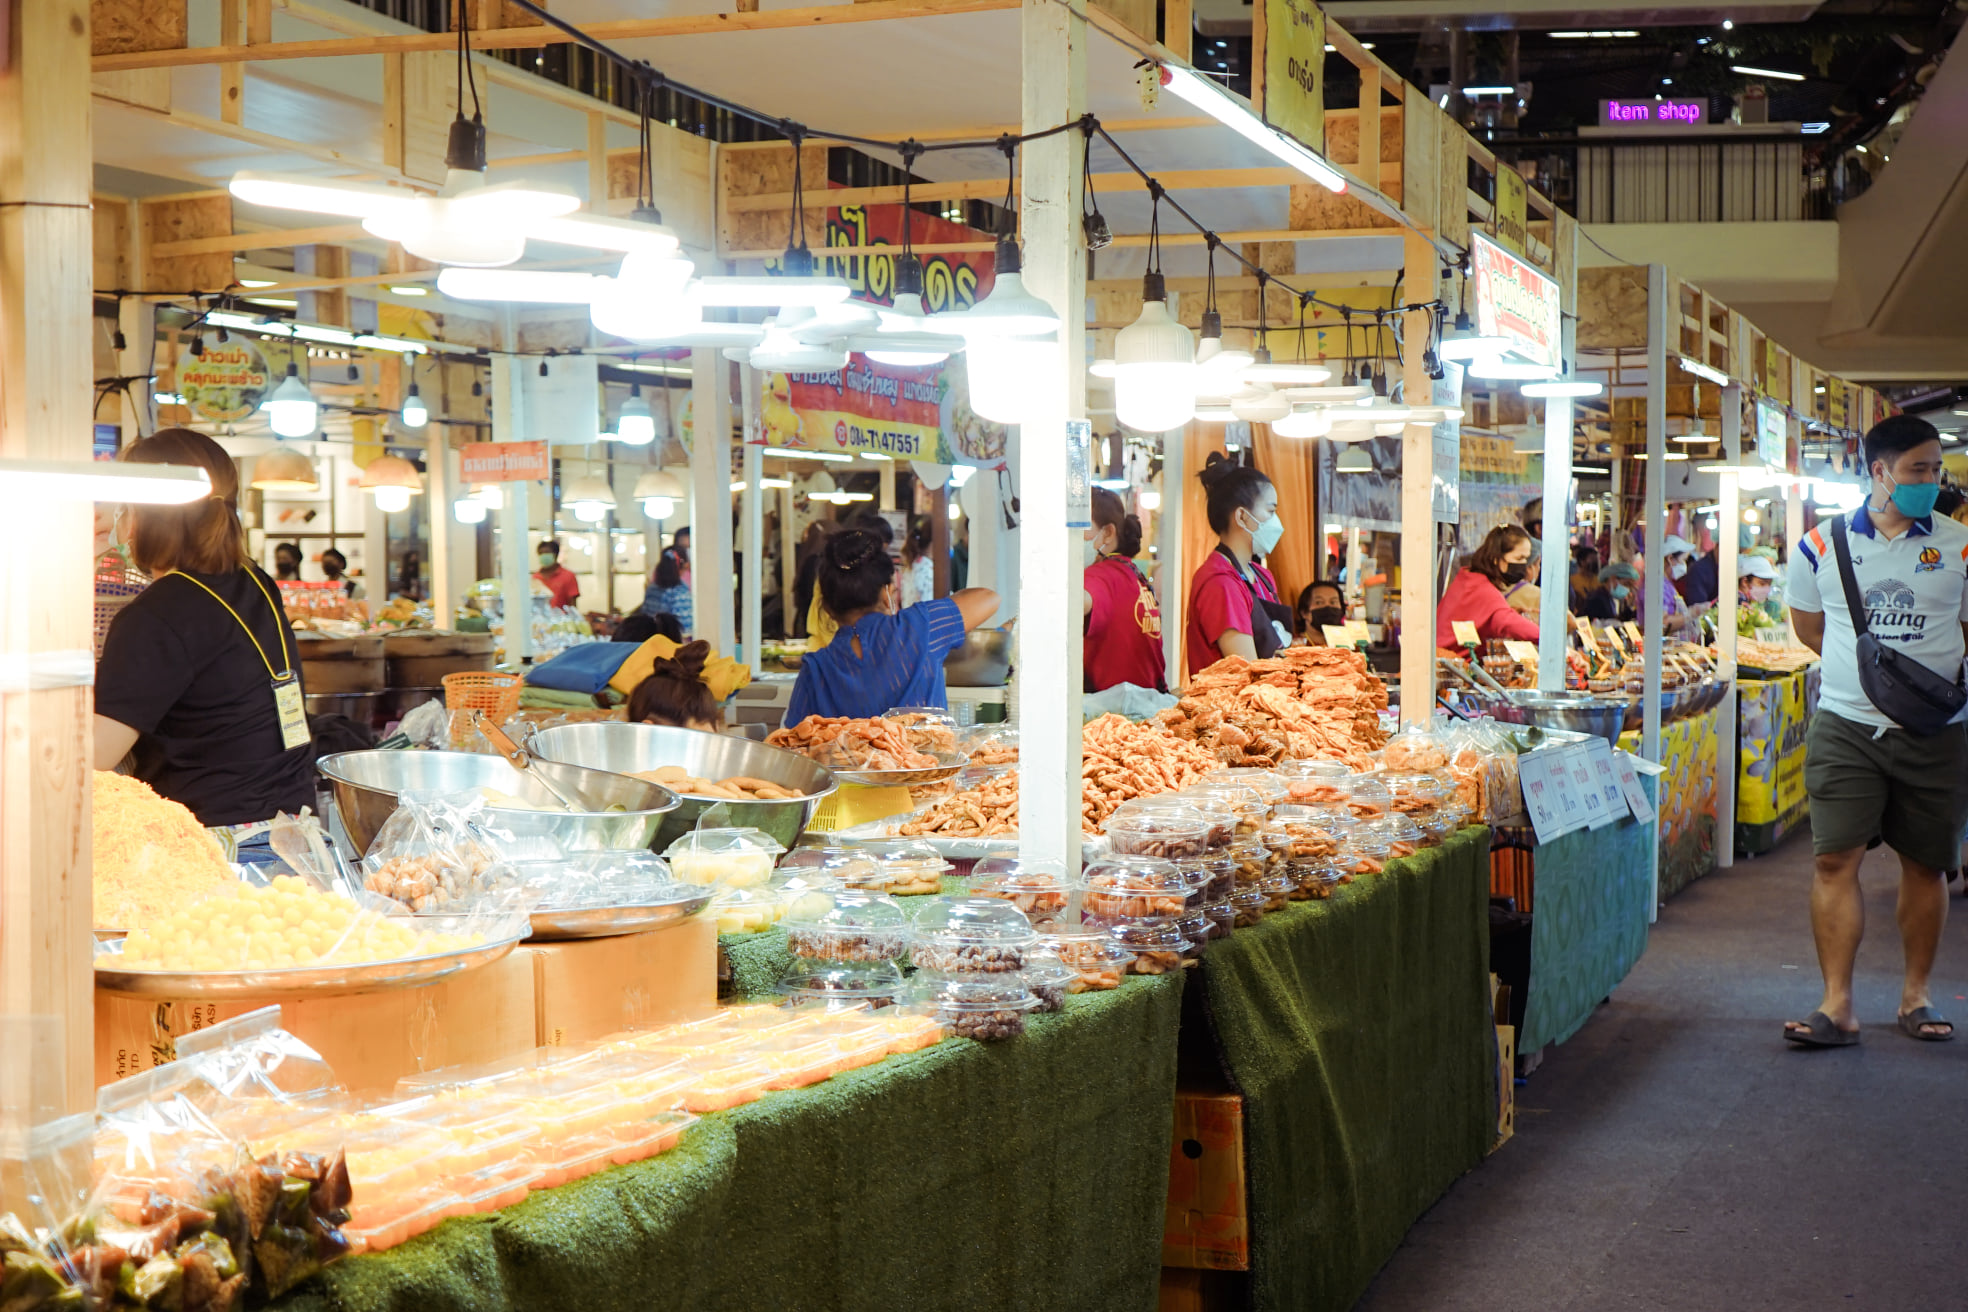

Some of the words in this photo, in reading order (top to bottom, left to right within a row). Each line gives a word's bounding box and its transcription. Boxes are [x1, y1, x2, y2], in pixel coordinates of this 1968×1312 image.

[1608, 100, 1649, 121] item
[1657, 100, 1700, 124] shop
[1864, 608, 1928, 632] hang
